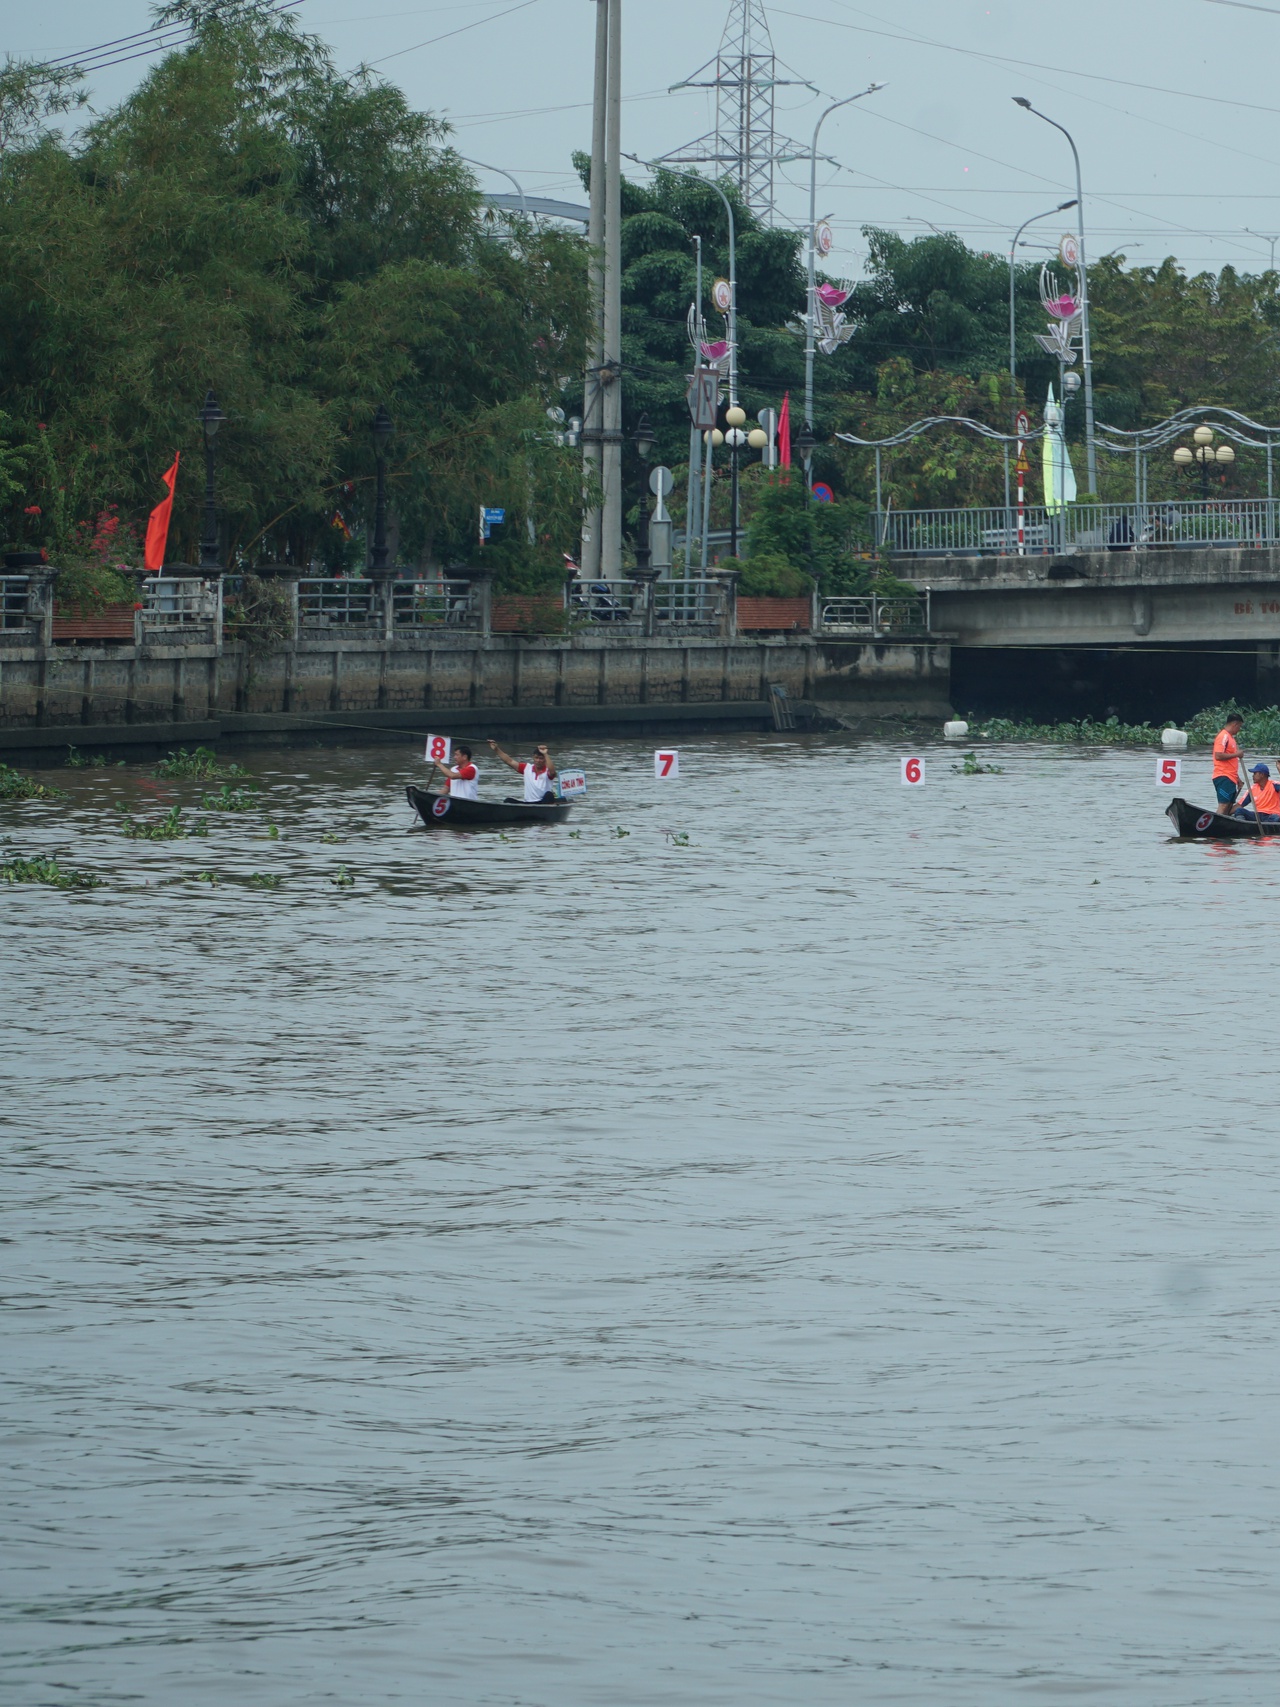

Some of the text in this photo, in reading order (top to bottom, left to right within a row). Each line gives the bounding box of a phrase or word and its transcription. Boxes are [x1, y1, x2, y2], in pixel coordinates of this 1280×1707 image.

[430, 737, 446, 760] 8
[659, 754, 674, 776] 7
[905, 758, 921, 783] 6
[1160, 760, 1177, 784] 5
[435, 798, 447, 814] 5
[1198, 815, 1212, 829] 3
